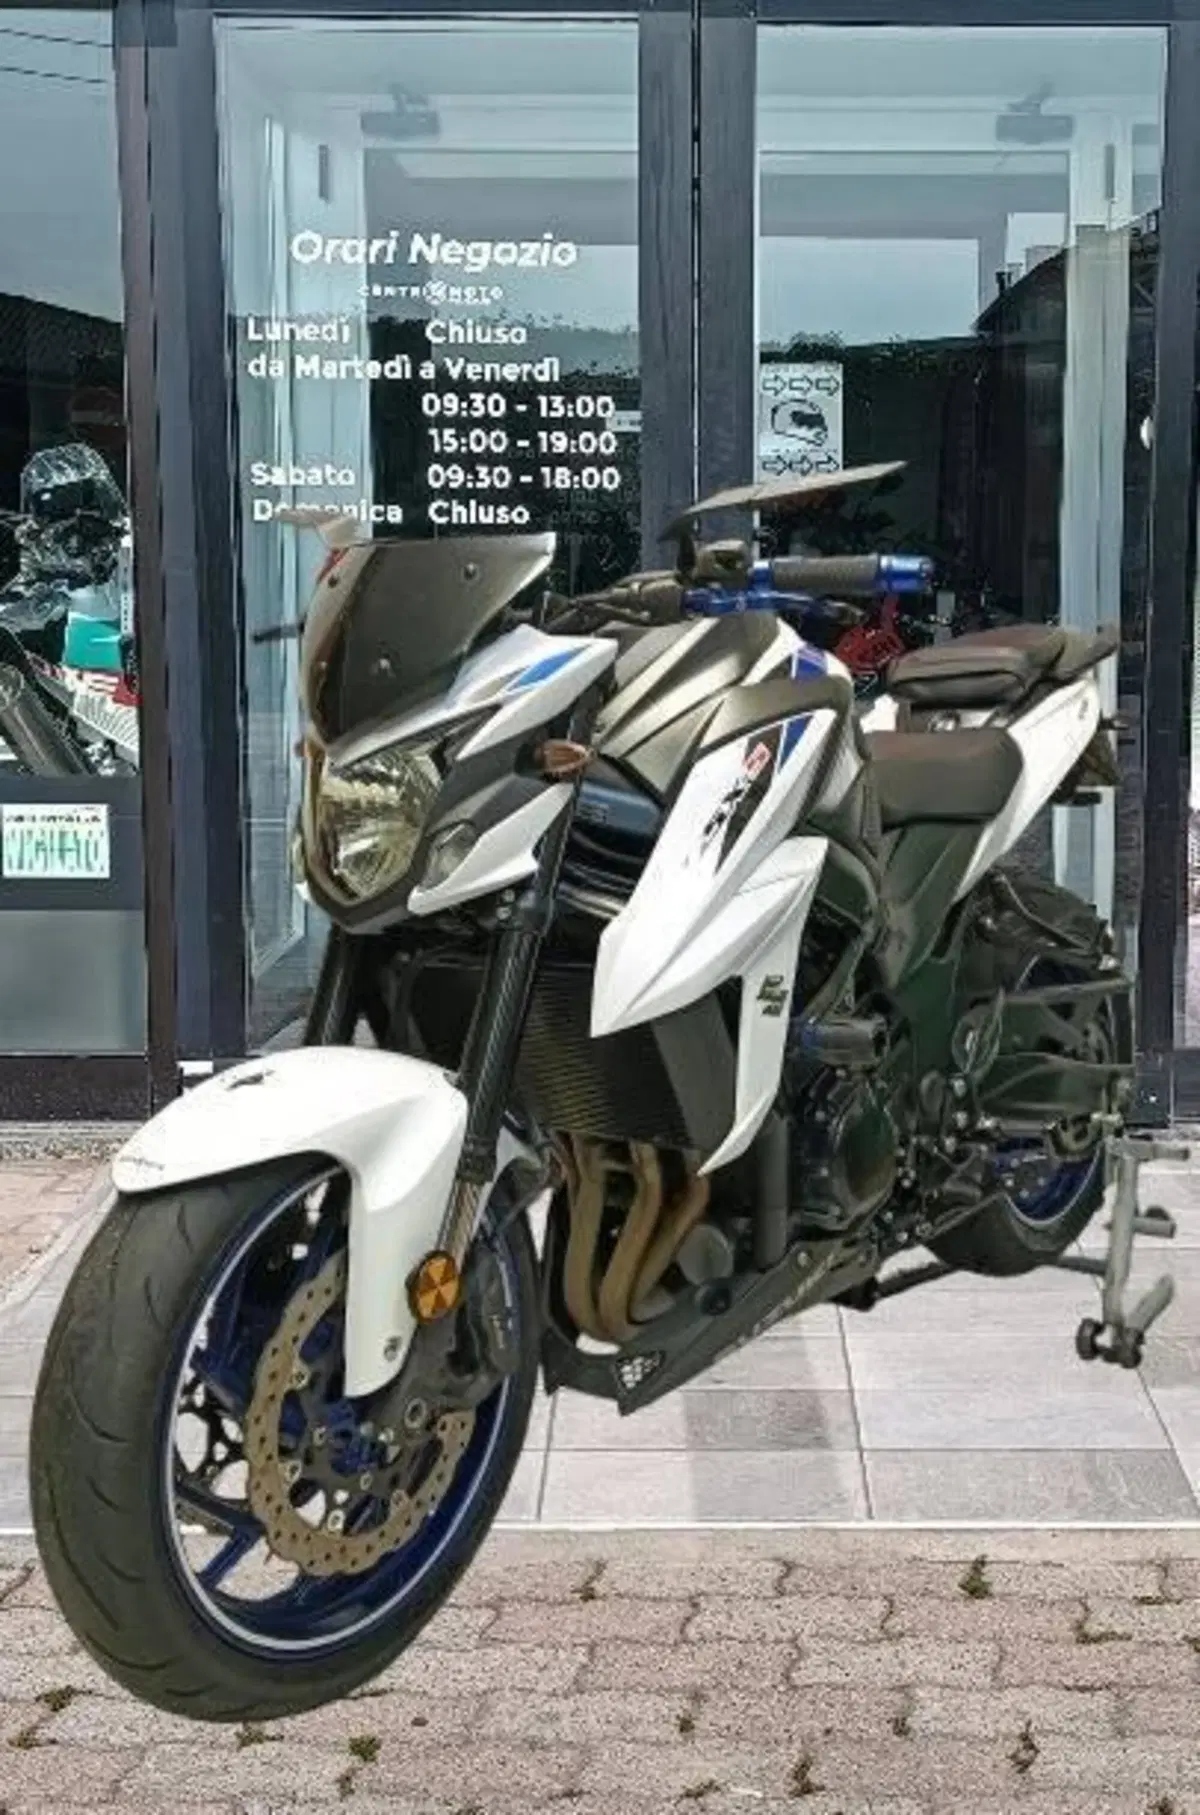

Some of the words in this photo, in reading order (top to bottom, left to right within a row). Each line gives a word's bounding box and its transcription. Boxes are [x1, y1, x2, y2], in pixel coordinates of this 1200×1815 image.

[291, 230, 399, 264] Orari
[408, 232, 578, 273] Negozio
[424, 319, 528, 345] Chiuso
[247, 353, 285, 379] da
[294, 354, 412, 380] Martedì
[419, 360, 436, 380] a
[443, 357, 561, 383] Venerdì
[421, 392, 507, 419] 09:30
[537, 395, 616, 419] 13:00
[428, 428, 508, 453] 15:00
[537, 431, 619, 455] 19:00
[250, 461, 356, 487] Sabato
[426, 464, 513, 490] 09:30
[541, 466, 622, 491] 18:00
[428, 501, 531, 525] Chiuso
